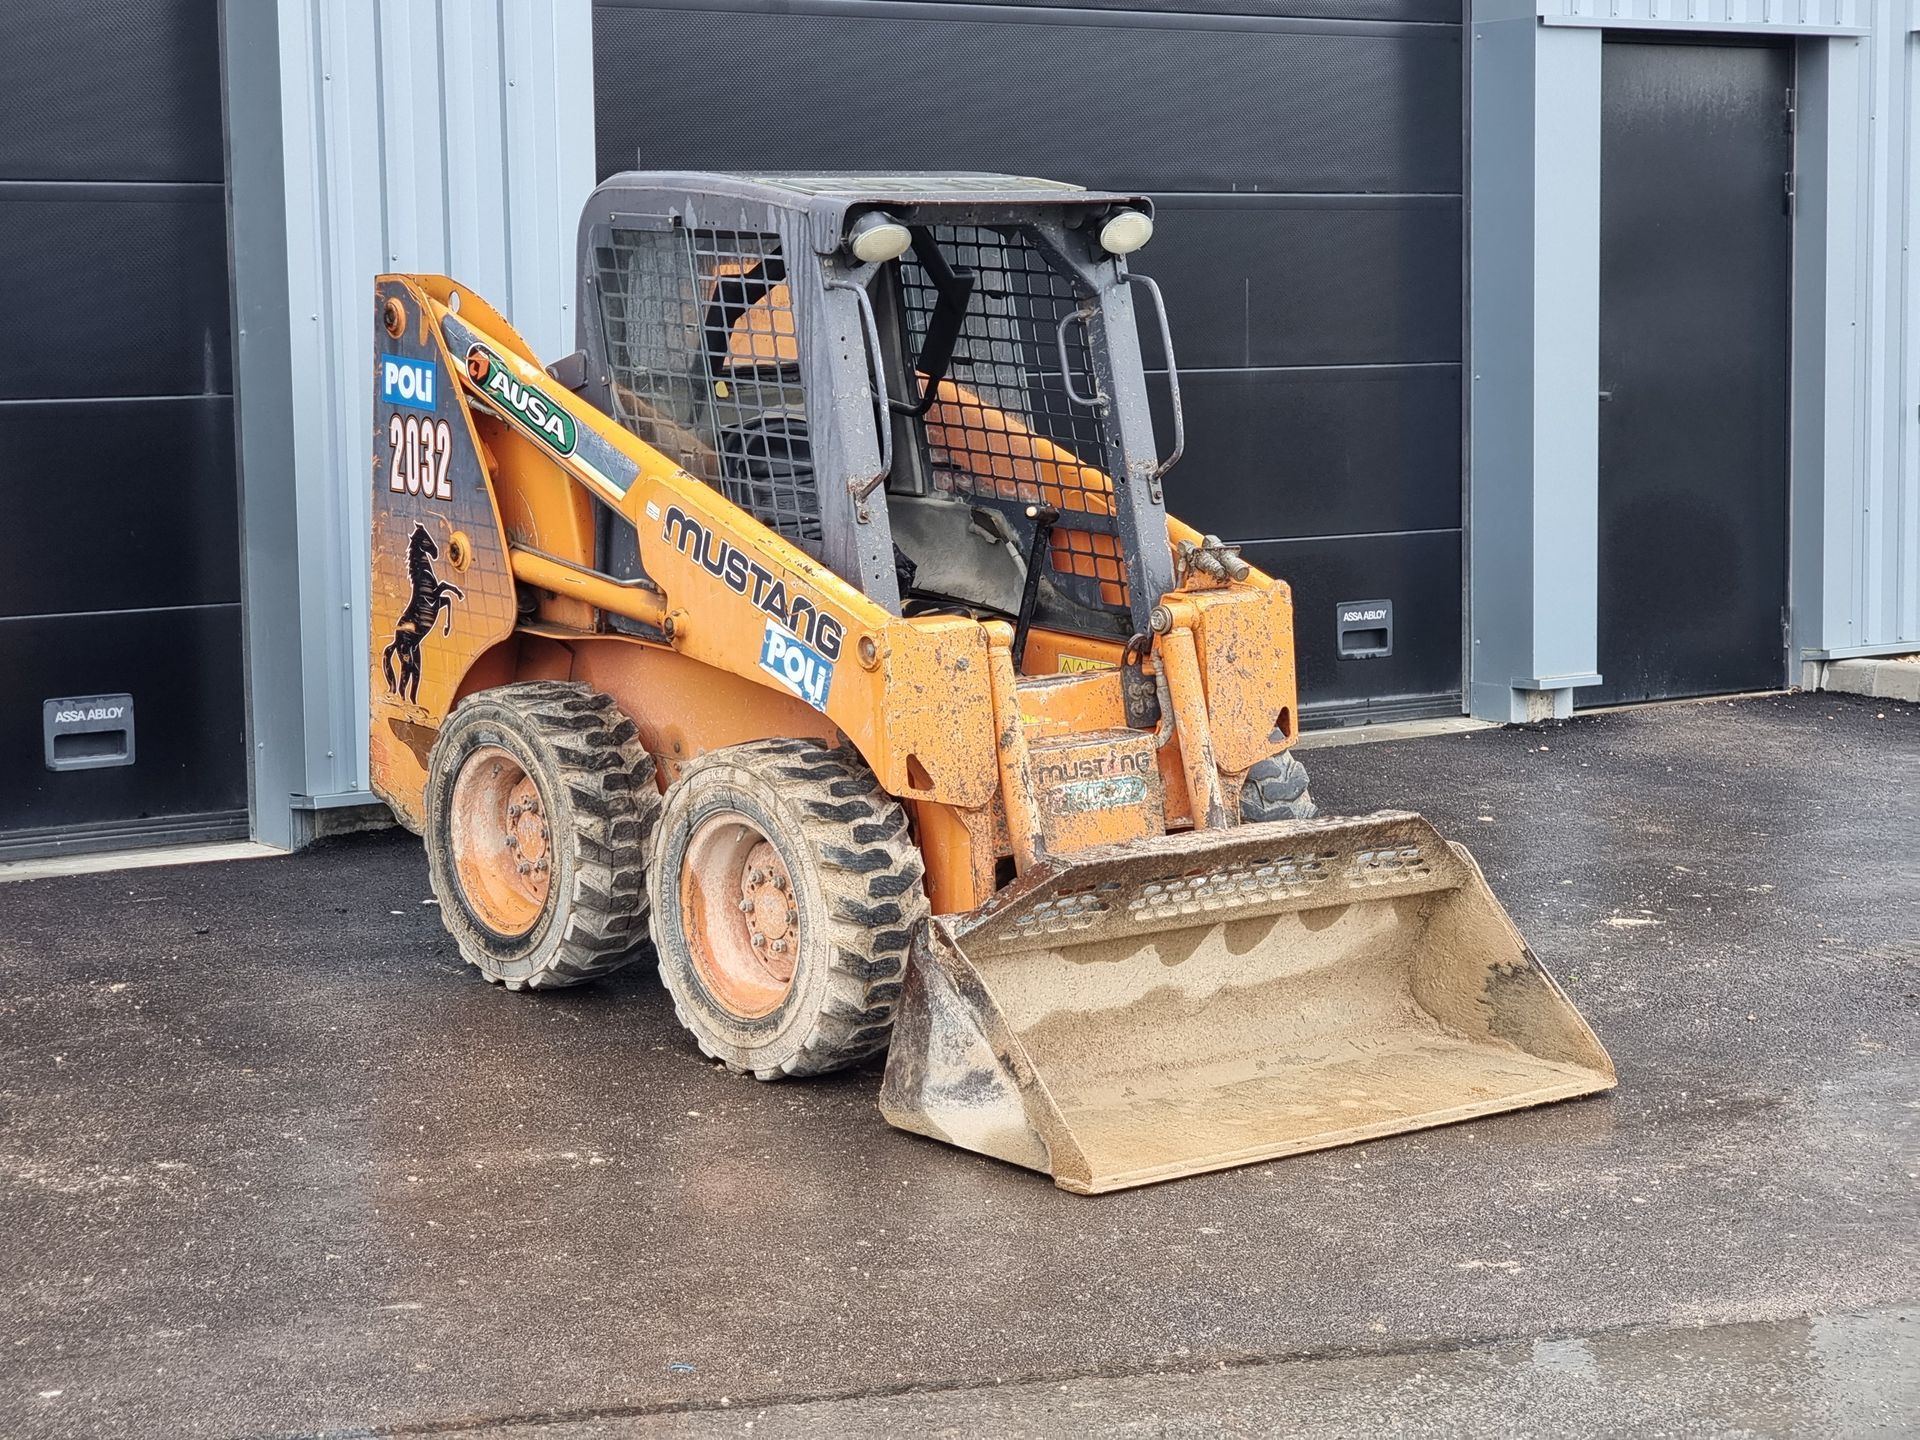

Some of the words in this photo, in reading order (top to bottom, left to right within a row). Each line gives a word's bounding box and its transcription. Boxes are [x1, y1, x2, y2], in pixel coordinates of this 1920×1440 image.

[489, 370, 567, 448] AUSA
[390, 413, 453, 502] 2032
[662, 505, 843, 662] MUSTANG
[1343, 612, 1363, 622] ASSA
[1364, 609, 1387, 620] ABLOY
[55, 710, 86, 723] ASSA
[87, 707, 124, 721] ABLOY
